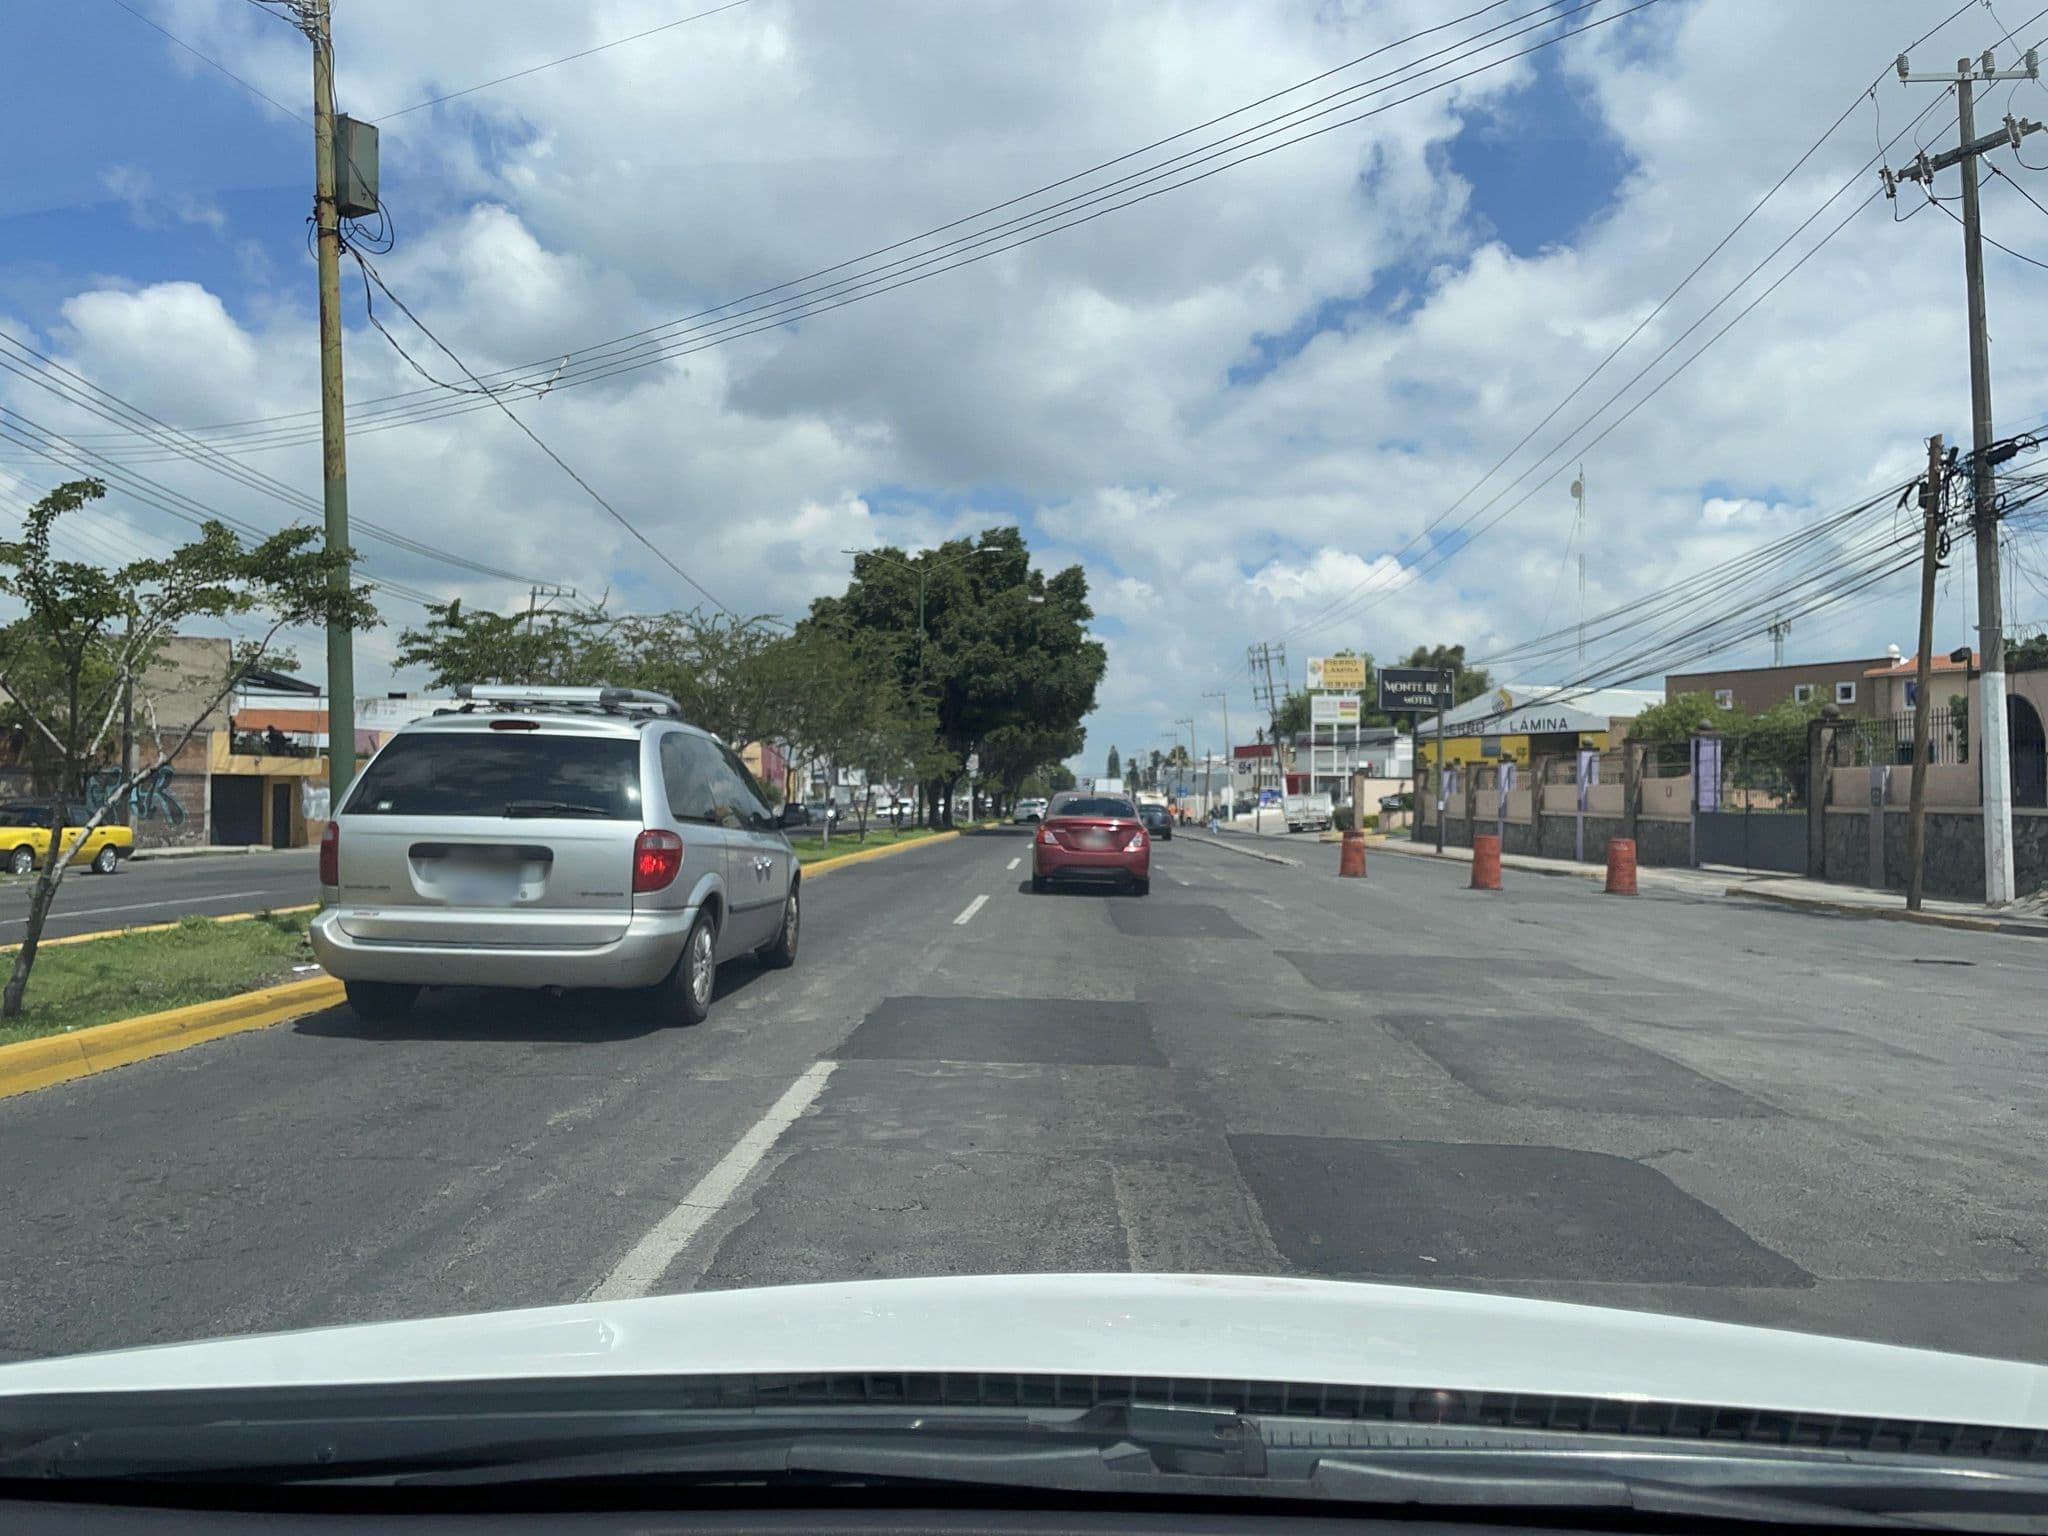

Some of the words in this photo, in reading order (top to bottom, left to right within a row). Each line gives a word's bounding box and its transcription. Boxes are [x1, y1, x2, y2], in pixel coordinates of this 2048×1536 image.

[1384, 680, 1424, 694] MONTE
[1425, 681, 1451, 695] REL
[1403, 695, 1433, 705] MOTEL
[1509, 715, 1569, 732] LÁMINA
